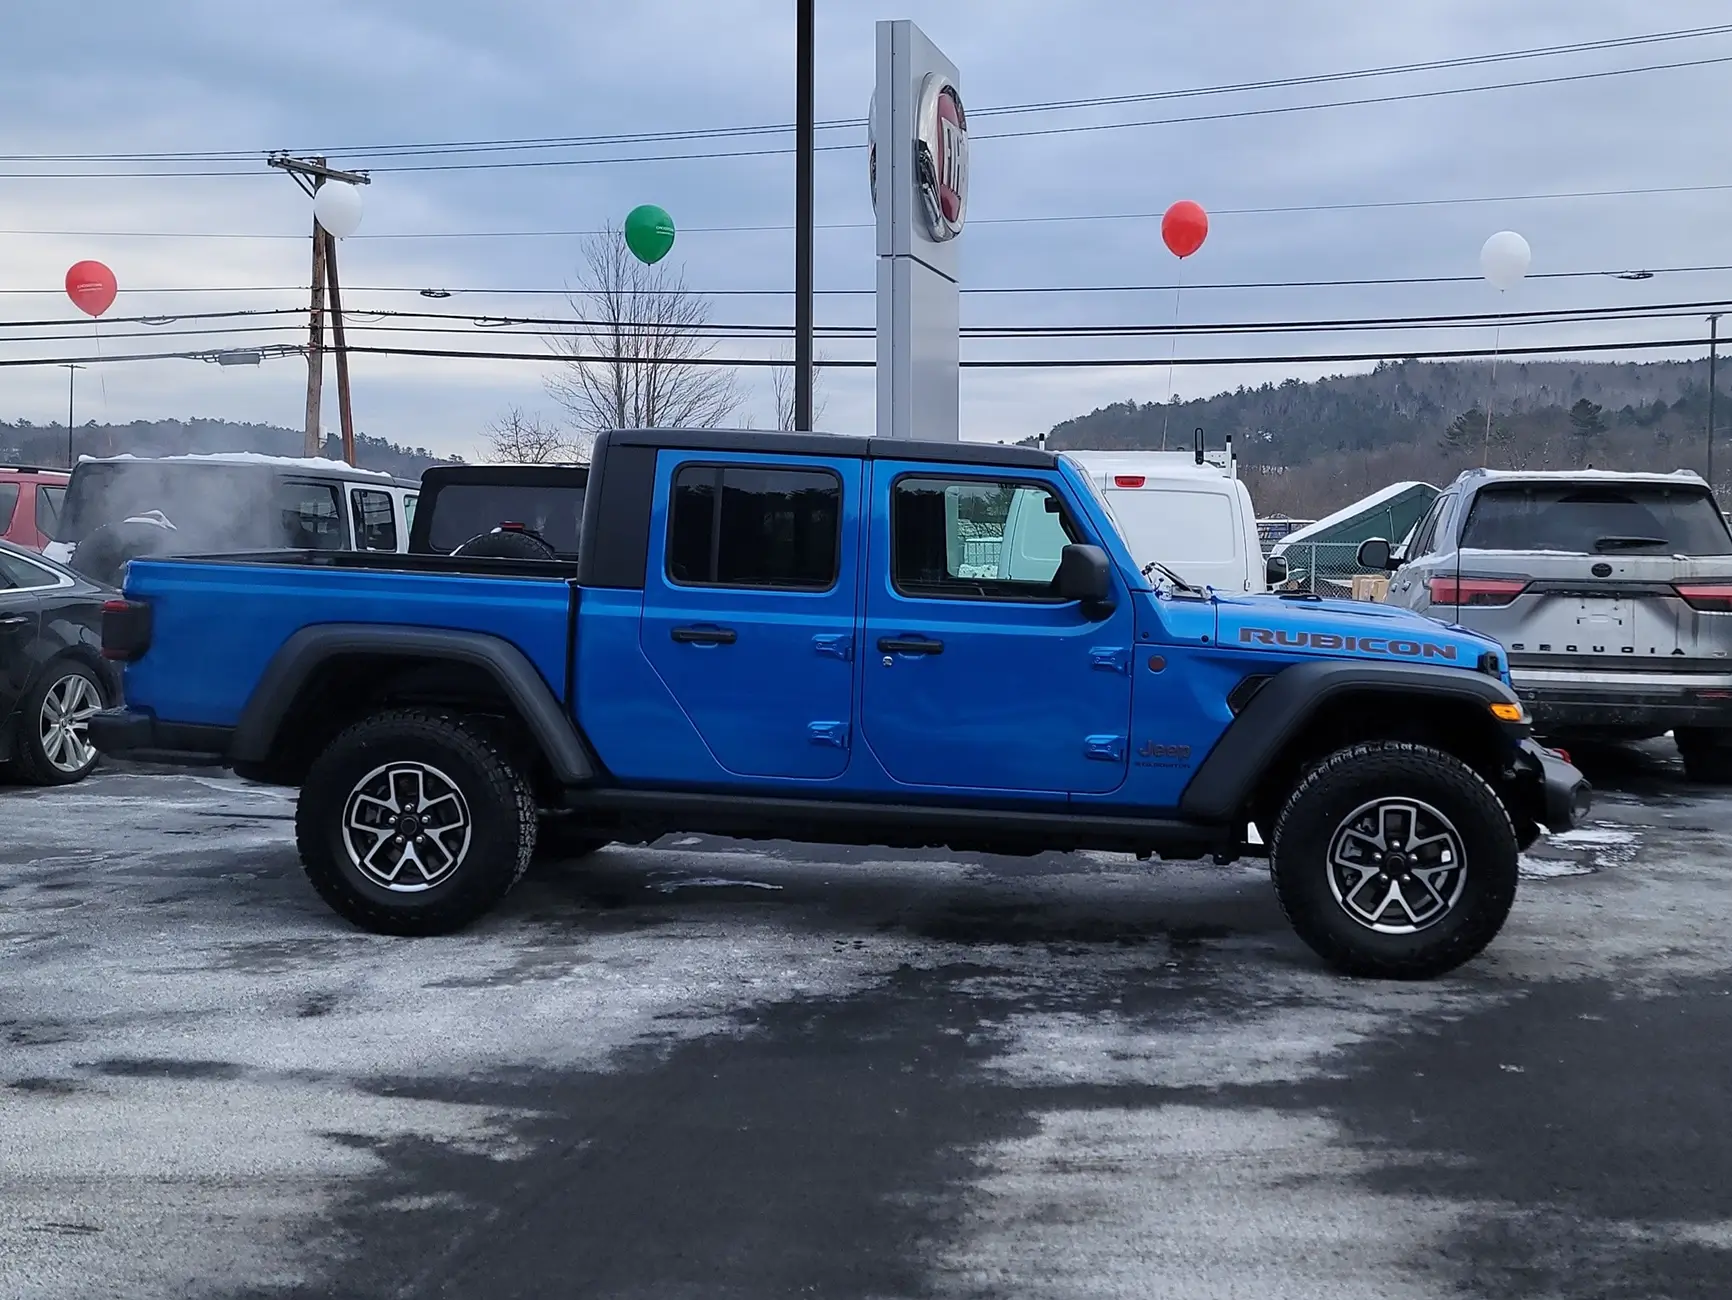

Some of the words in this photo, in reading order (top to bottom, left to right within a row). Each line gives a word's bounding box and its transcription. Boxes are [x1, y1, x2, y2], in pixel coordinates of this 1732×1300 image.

[1239, 627, 1457, 661] RUBICON
[1511, 643, 1686, 655] SEQUOIA
[1138, 739, 1191, 761] Jeep
